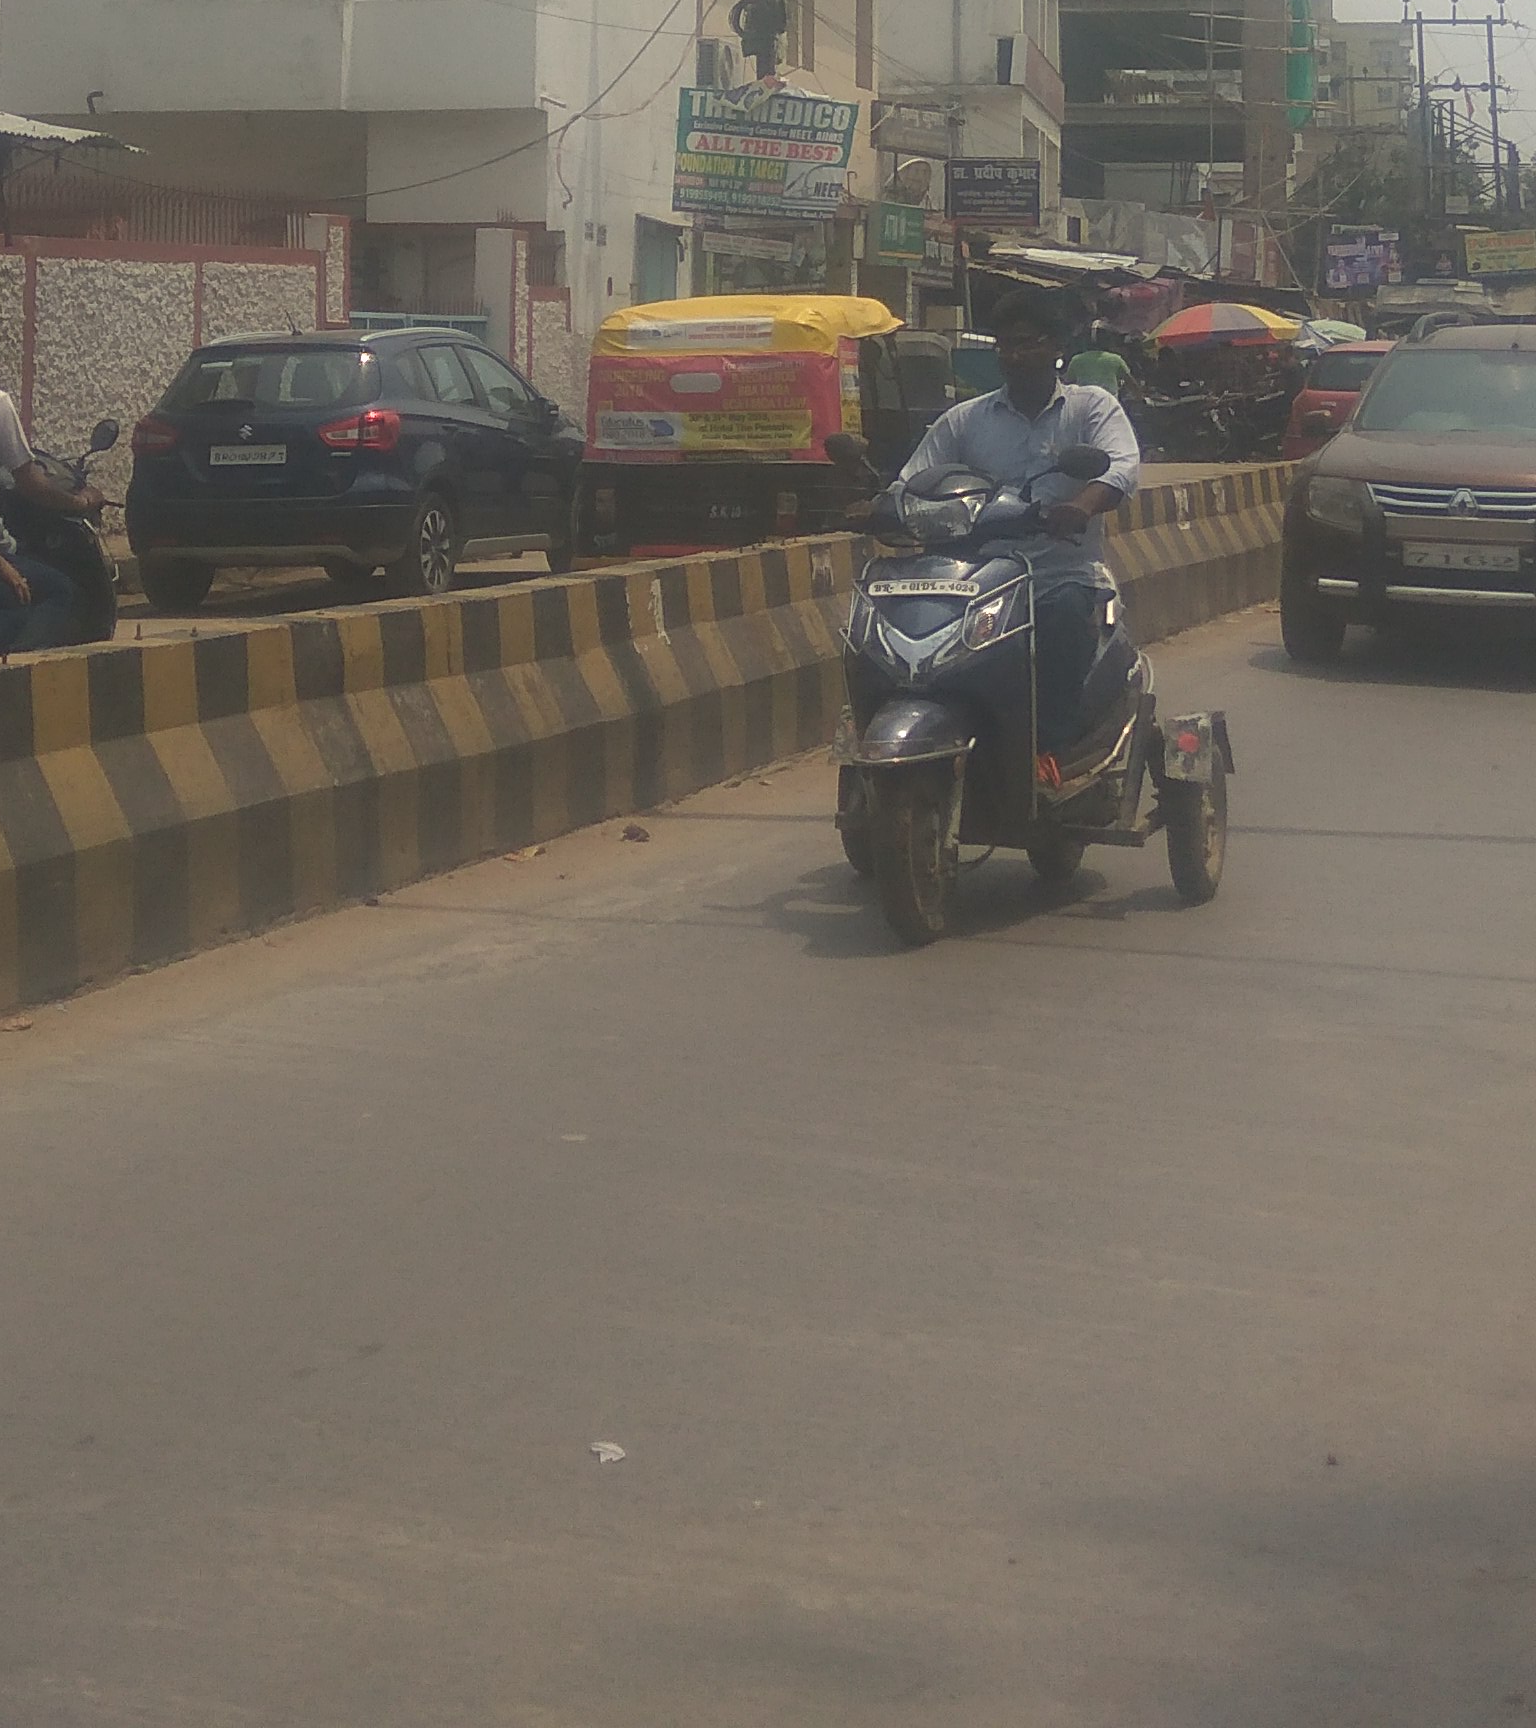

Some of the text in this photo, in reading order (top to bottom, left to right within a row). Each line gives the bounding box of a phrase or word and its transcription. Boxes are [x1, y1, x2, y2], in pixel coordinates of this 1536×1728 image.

[788, 128, 815, 142] NEET,
[694, 134, 839, 162] ALL THE BEST
[738, 158, 746, 178] &
[749, 159, 787, 181] TARGET
[973, 164, 1038, 184] प्रदीप कुमार
